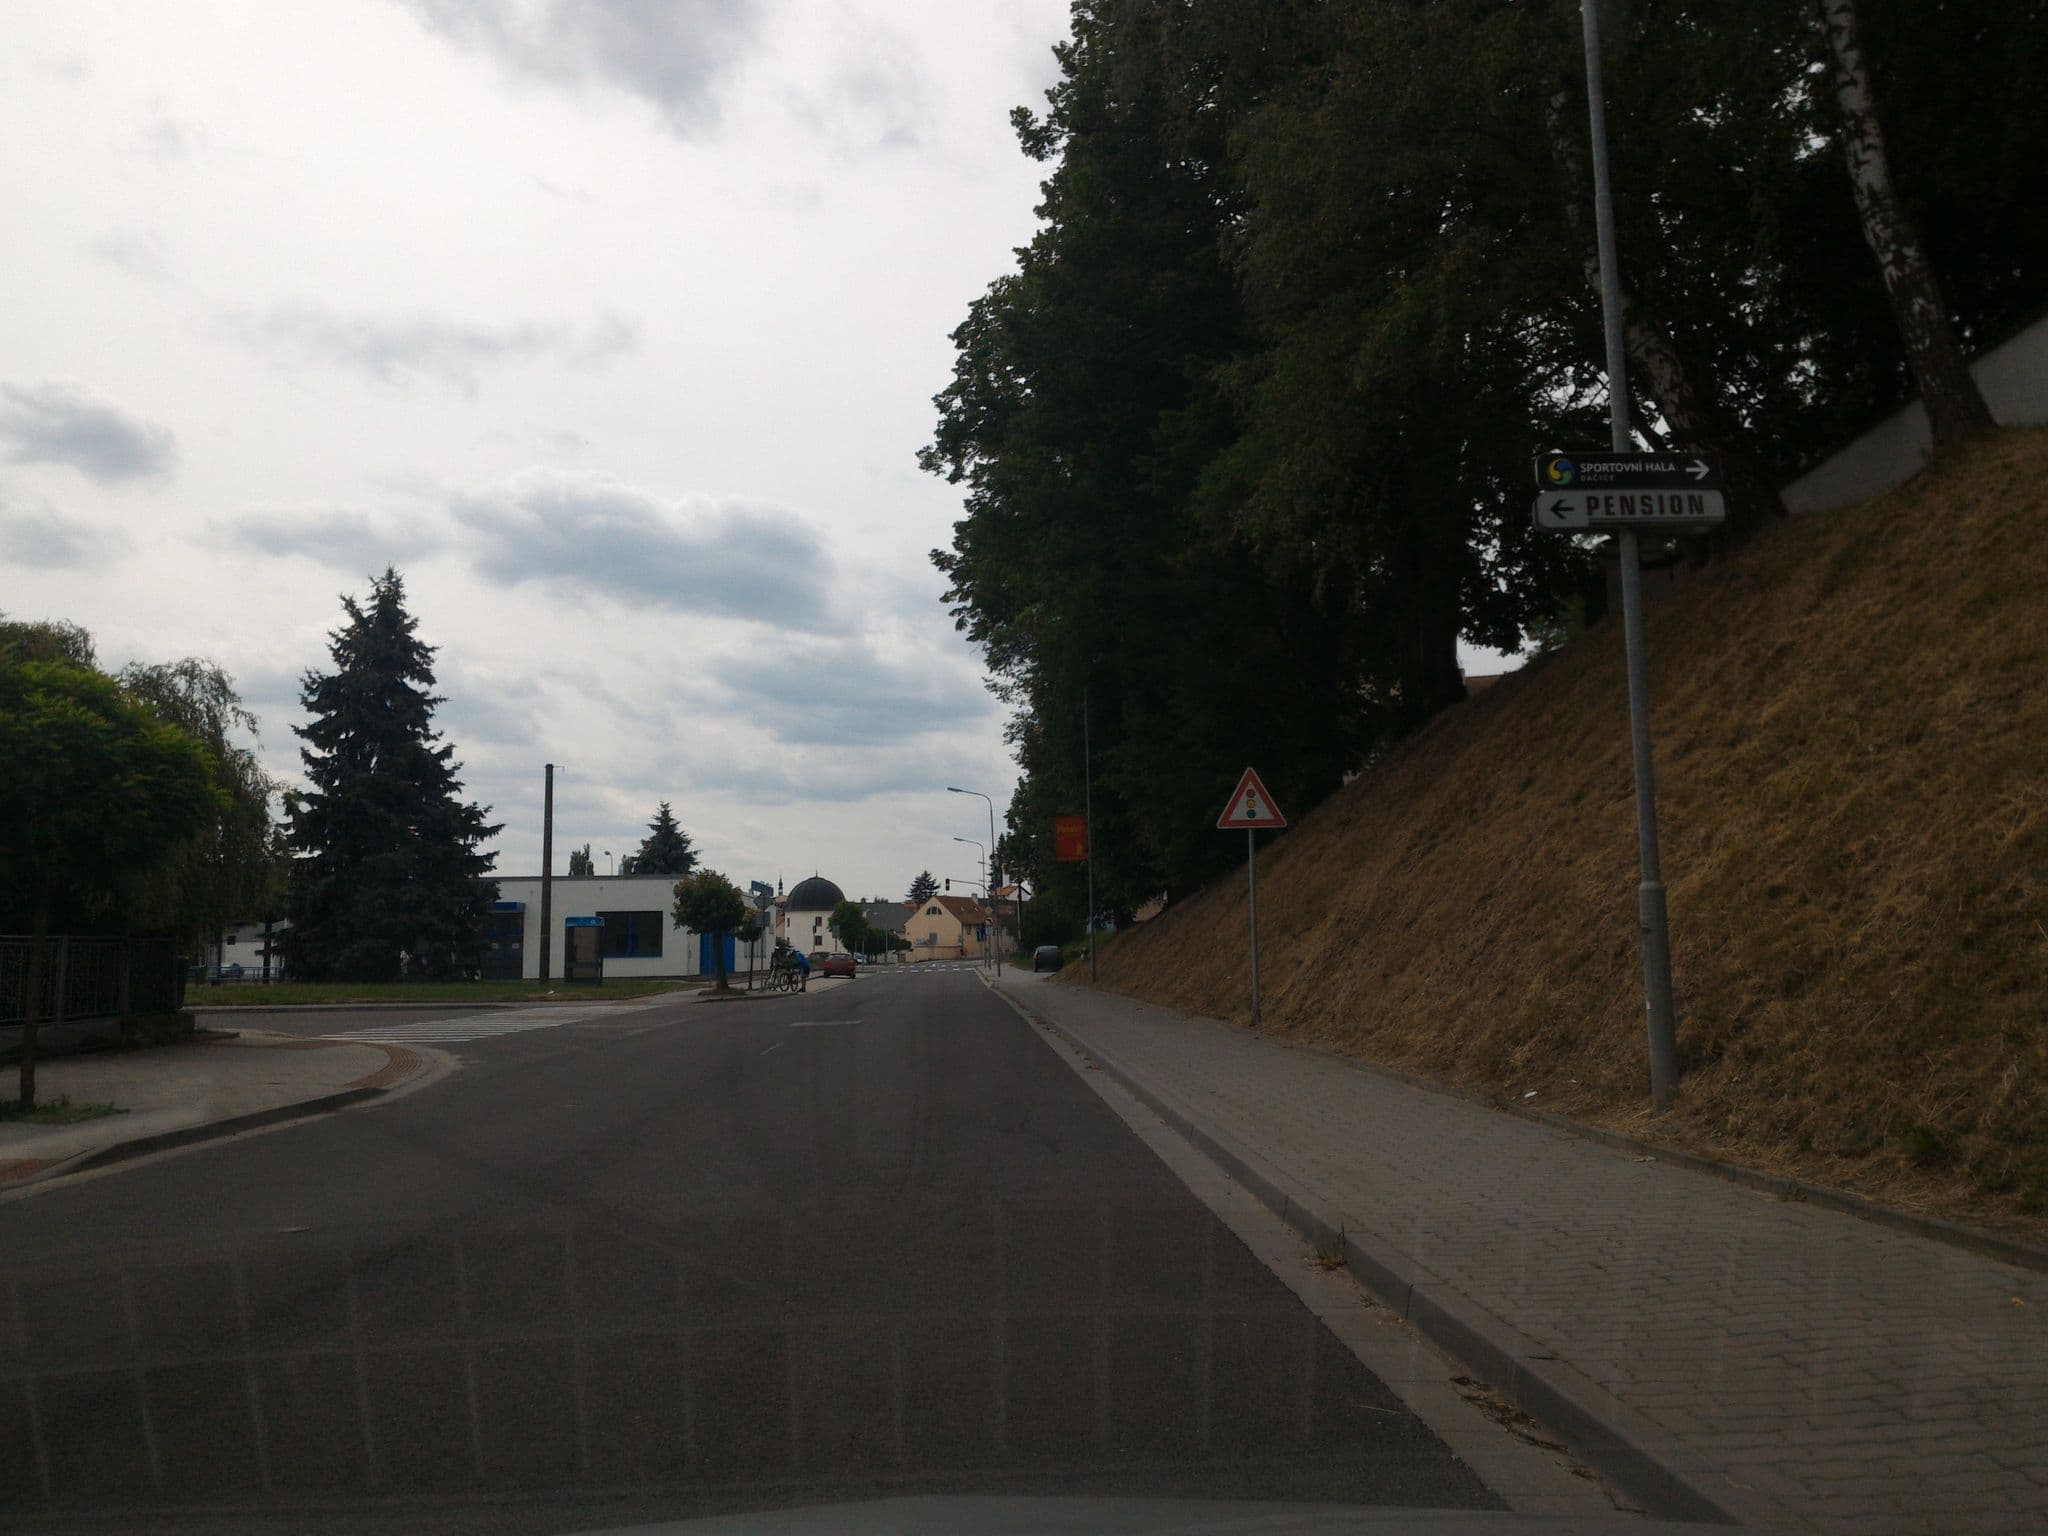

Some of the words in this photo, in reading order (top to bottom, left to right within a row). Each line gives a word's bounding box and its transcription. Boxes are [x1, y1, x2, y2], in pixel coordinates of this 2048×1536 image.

[1580, 461, 1643, 473] SPORTOVNÍ
[1646, 462, 1676, 473] HALA
[1586, 495, 1705, 515] PENSION
